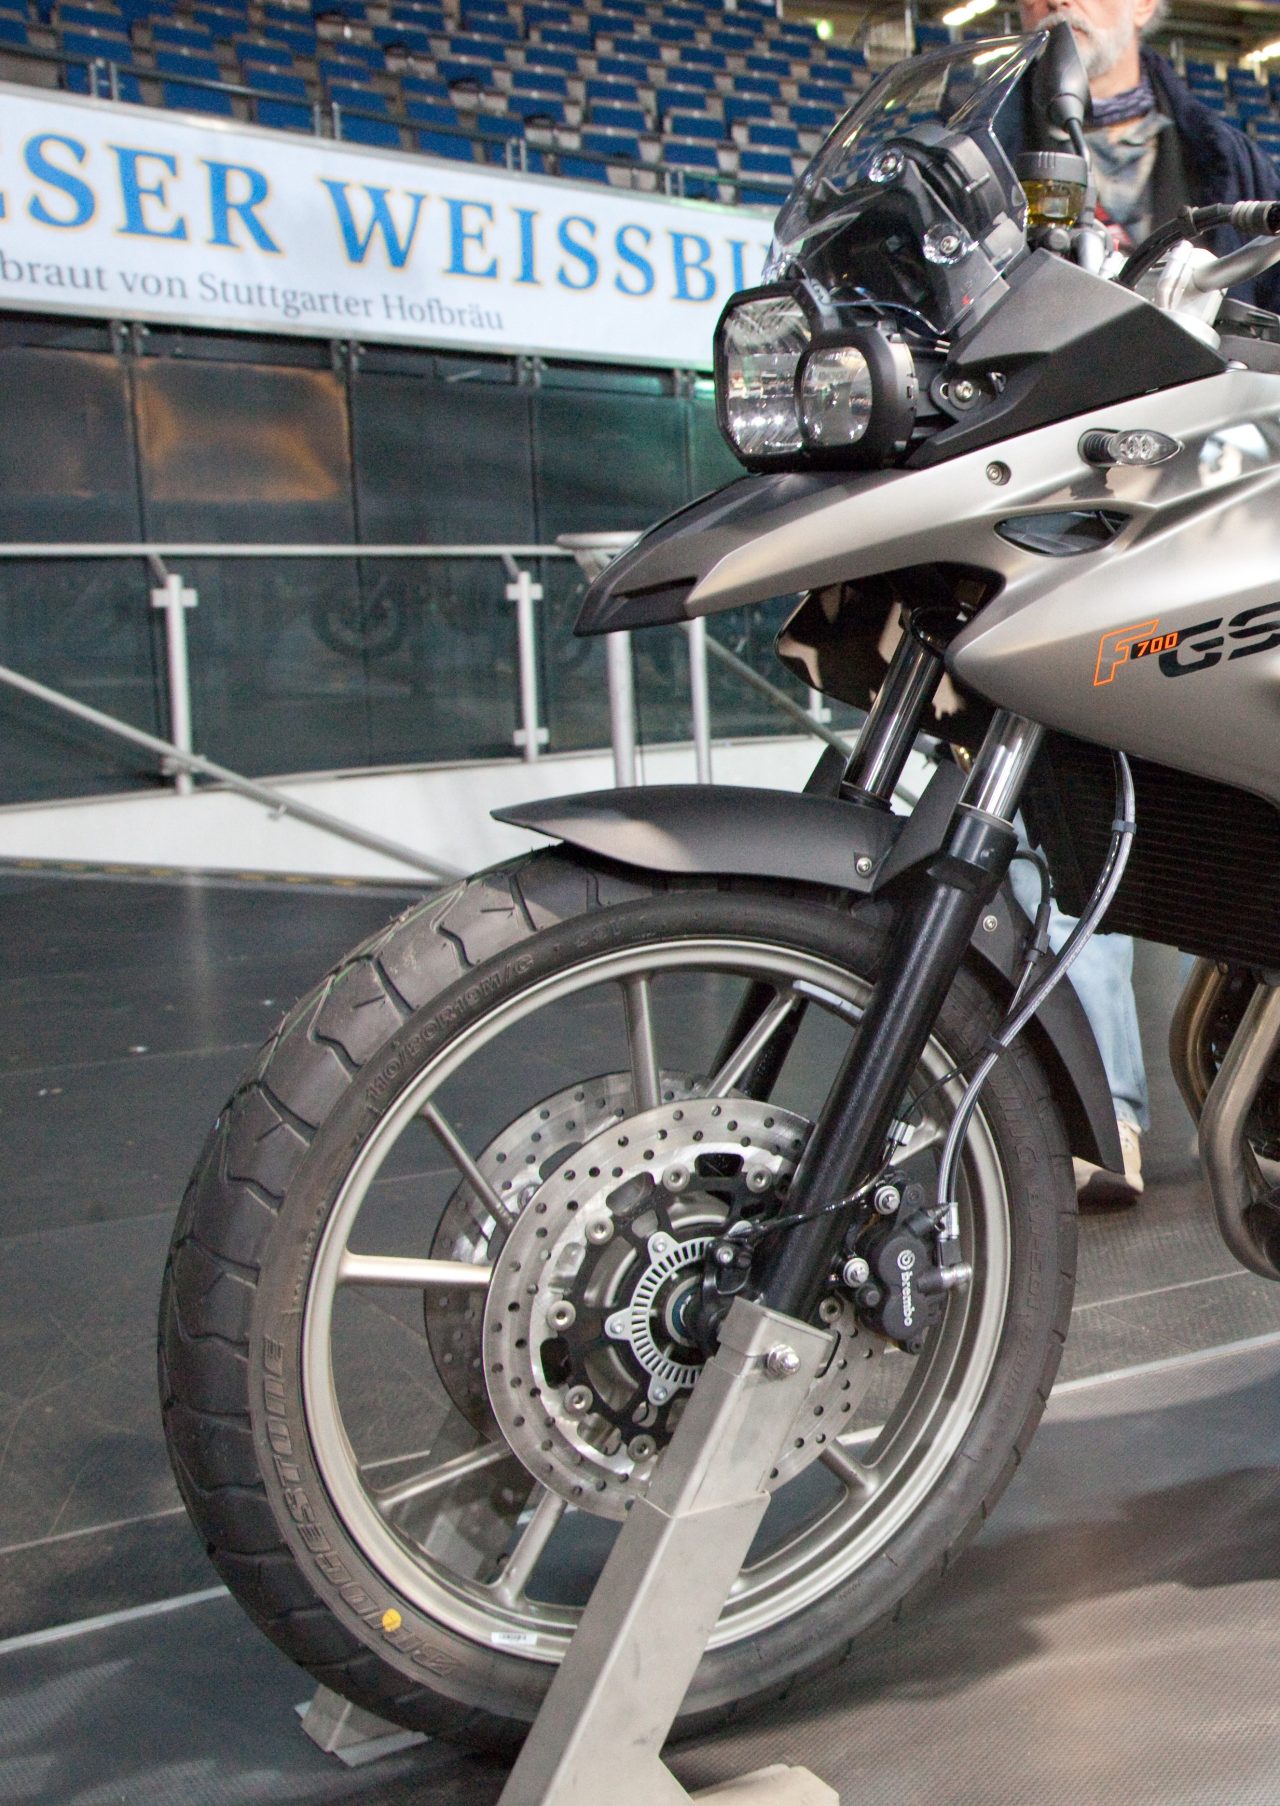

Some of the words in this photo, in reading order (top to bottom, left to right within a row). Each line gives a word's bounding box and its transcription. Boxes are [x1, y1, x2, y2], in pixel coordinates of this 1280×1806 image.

[0, 132, 284, 254] SER
[320, 178, 769, 303] WEISSBI
[119, 271, 188, 300] von
[198, 272, 373, 319] Stuttgarter
[382, 293, 504, 331] Hofbräu
[1093, 619, 1160, 686] F
[1137, 632, 1178, 657] 700
[900, 1271, 917, 1327] brembo
